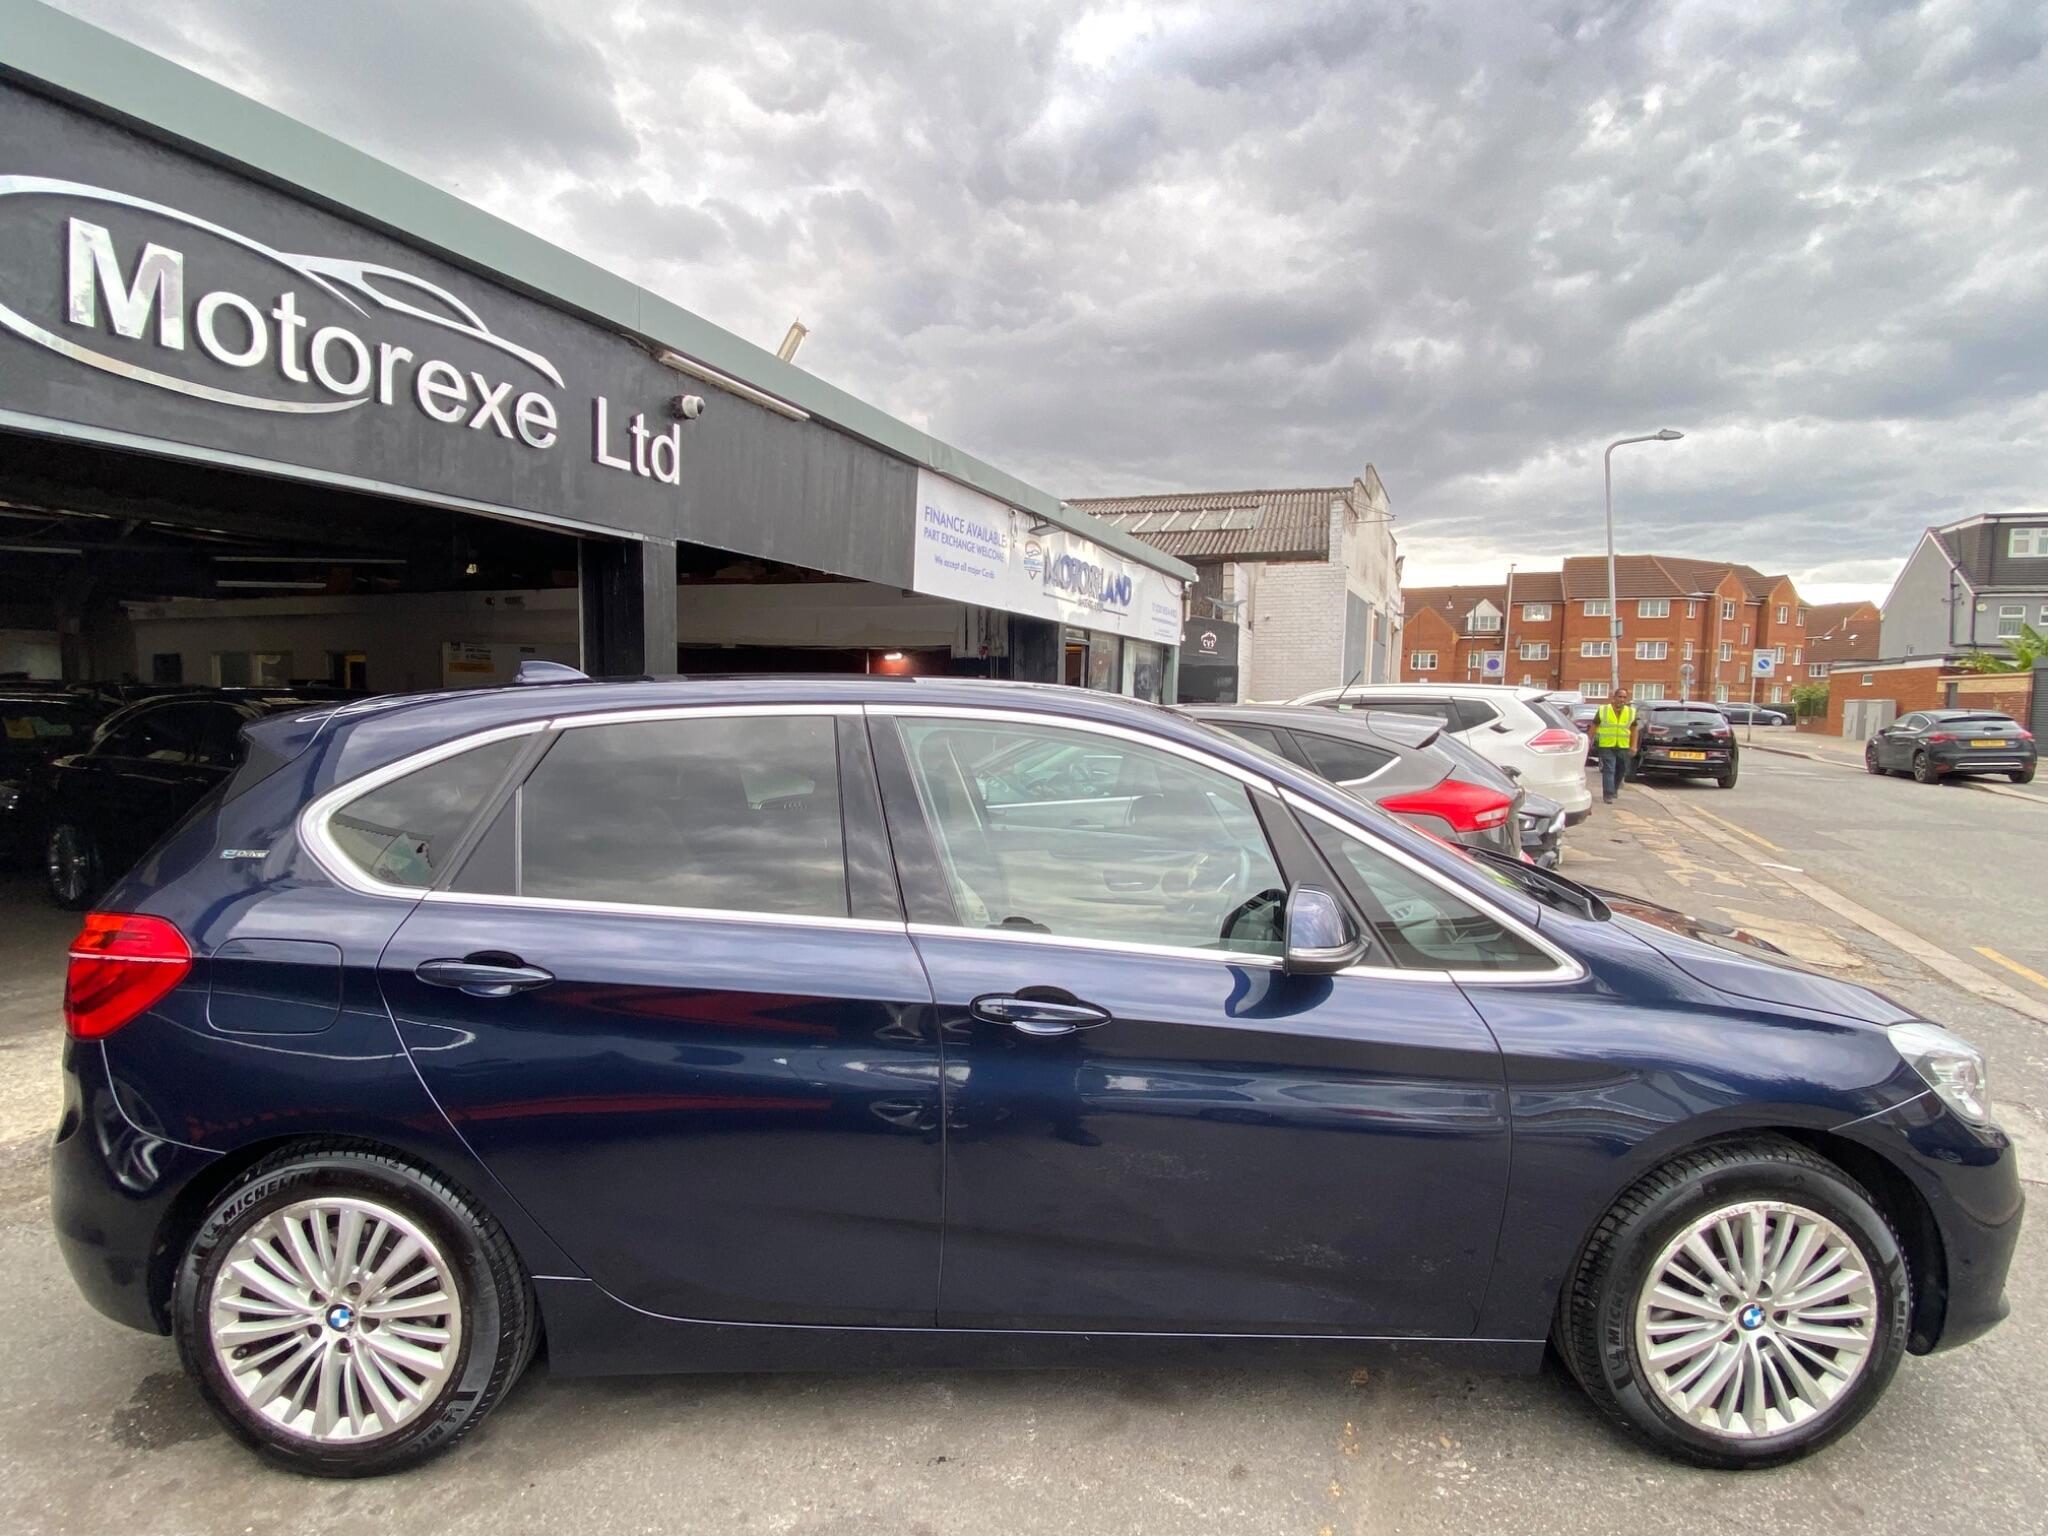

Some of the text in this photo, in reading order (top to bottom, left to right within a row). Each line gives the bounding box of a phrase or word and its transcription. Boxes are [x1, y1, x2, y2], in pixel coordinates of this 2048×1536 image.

[68, 216, 682, 486] Motorexe Ltd
[924, 505, 966, 534] FINANCE
[923, 526, 941, 543] PART
[941, 532, 976, 554] EXCHANGE
